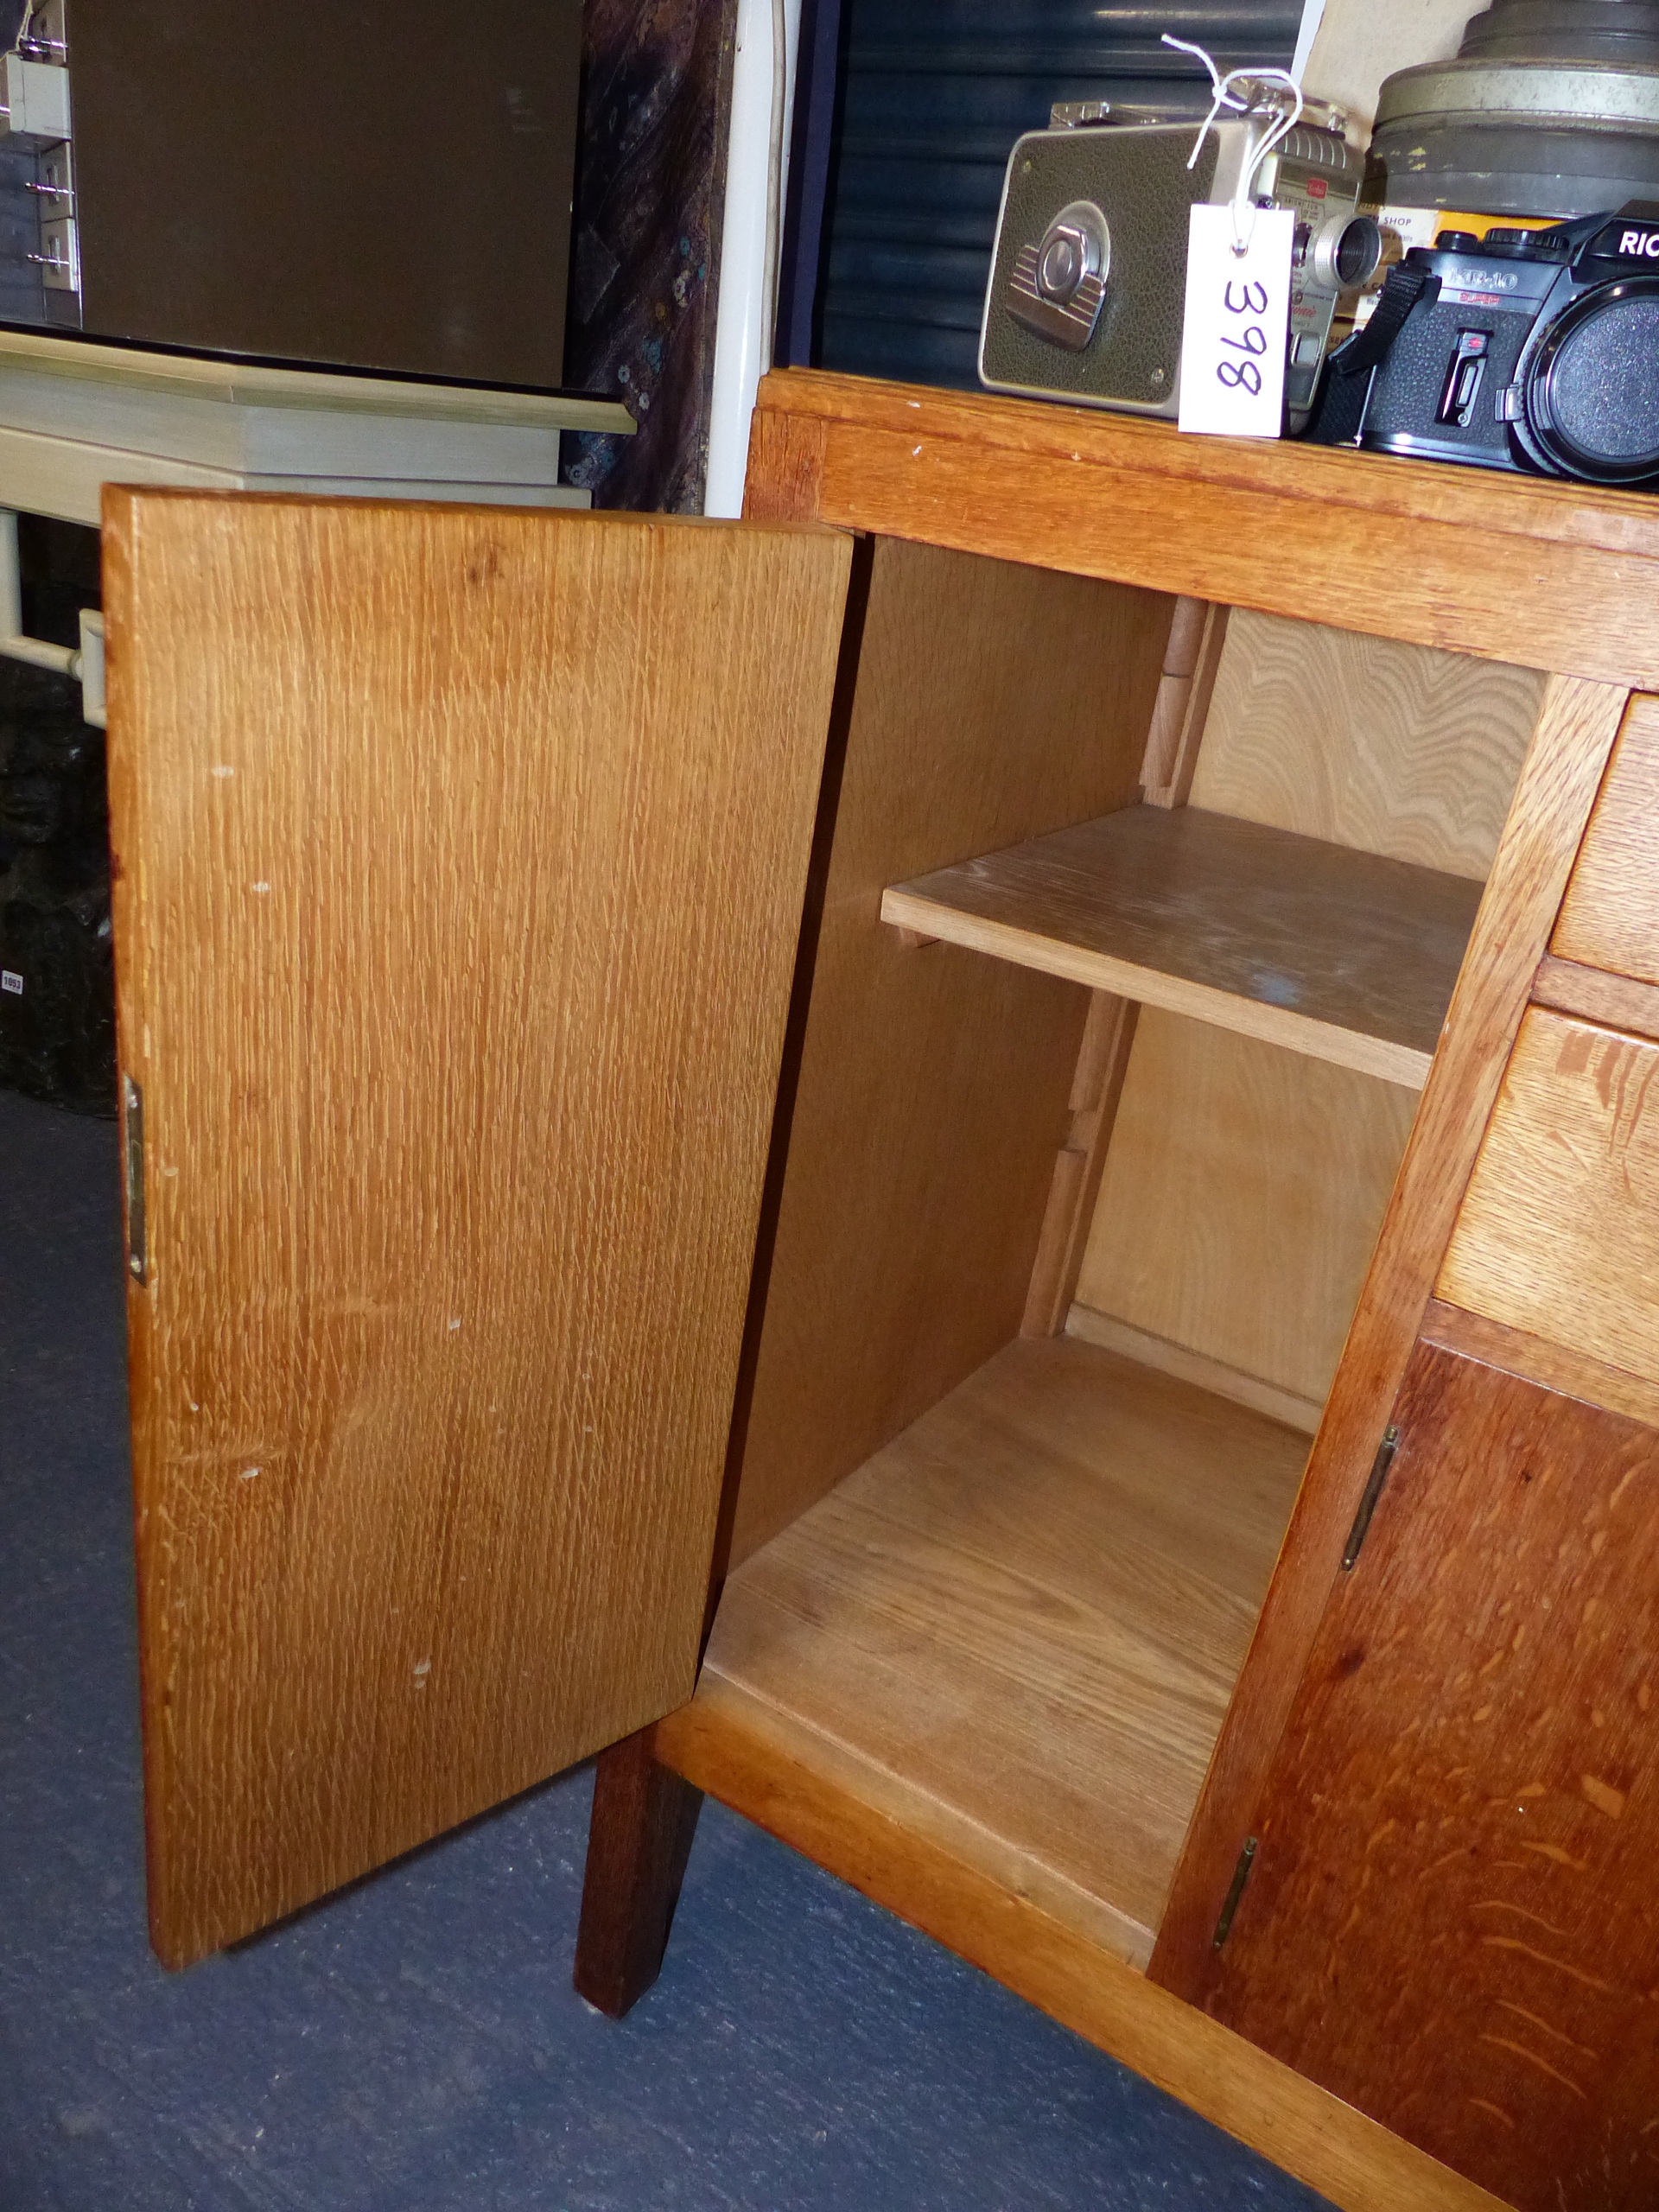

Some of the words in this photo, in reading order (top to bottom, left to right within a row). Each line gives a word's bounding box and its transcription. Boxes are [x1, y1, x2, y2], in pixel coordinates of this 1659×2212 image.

[1383, 216, 1412, 226] SHOP
[1618, 231, 1659, 257] RIC
[1217, 281, 1268, 396] 398
[3, 976, 22, 990] 1053
